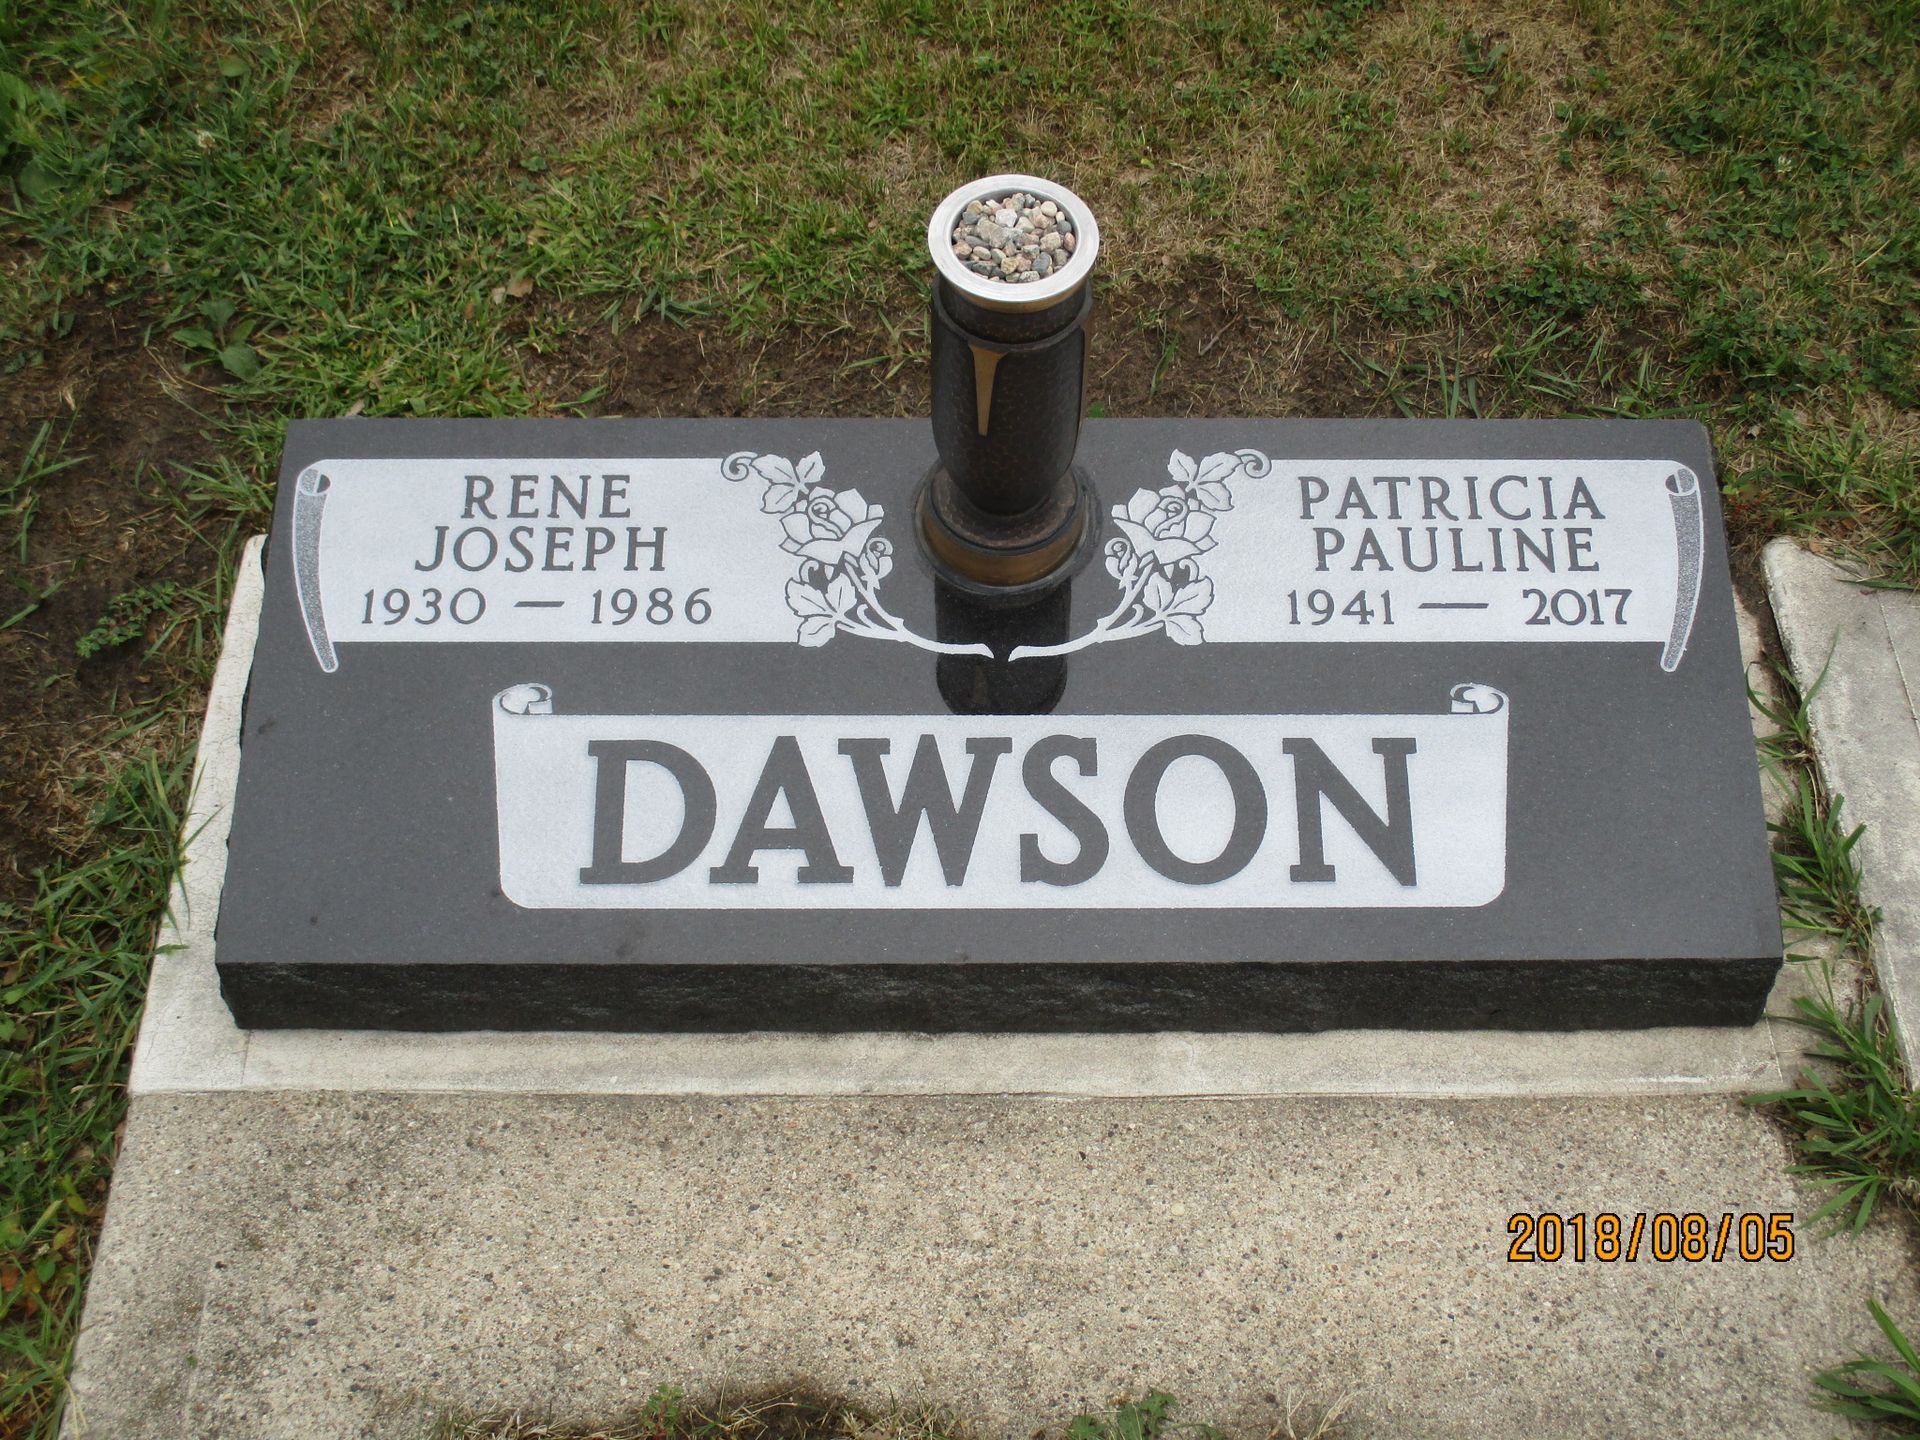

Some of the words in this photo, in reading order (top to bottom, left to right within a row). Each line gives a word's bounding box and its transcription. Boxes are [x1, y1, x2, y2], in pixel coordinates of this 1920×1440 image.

[461, 475, 630, 519] RENE
[1298, 475, 1606, 520] PATRICIA
[415, 526, 667, 572] JOSEPH
[1313, 527, 1599, 573] PAULINE
[362, 588, 485, 625] 1930
[592, 588, 711, 625] 1986
[1288, 589, 1394, 625] 1941
[1523, 589, 1632, 625] 2017
[580, 734, 1417, 887] DAWSON
